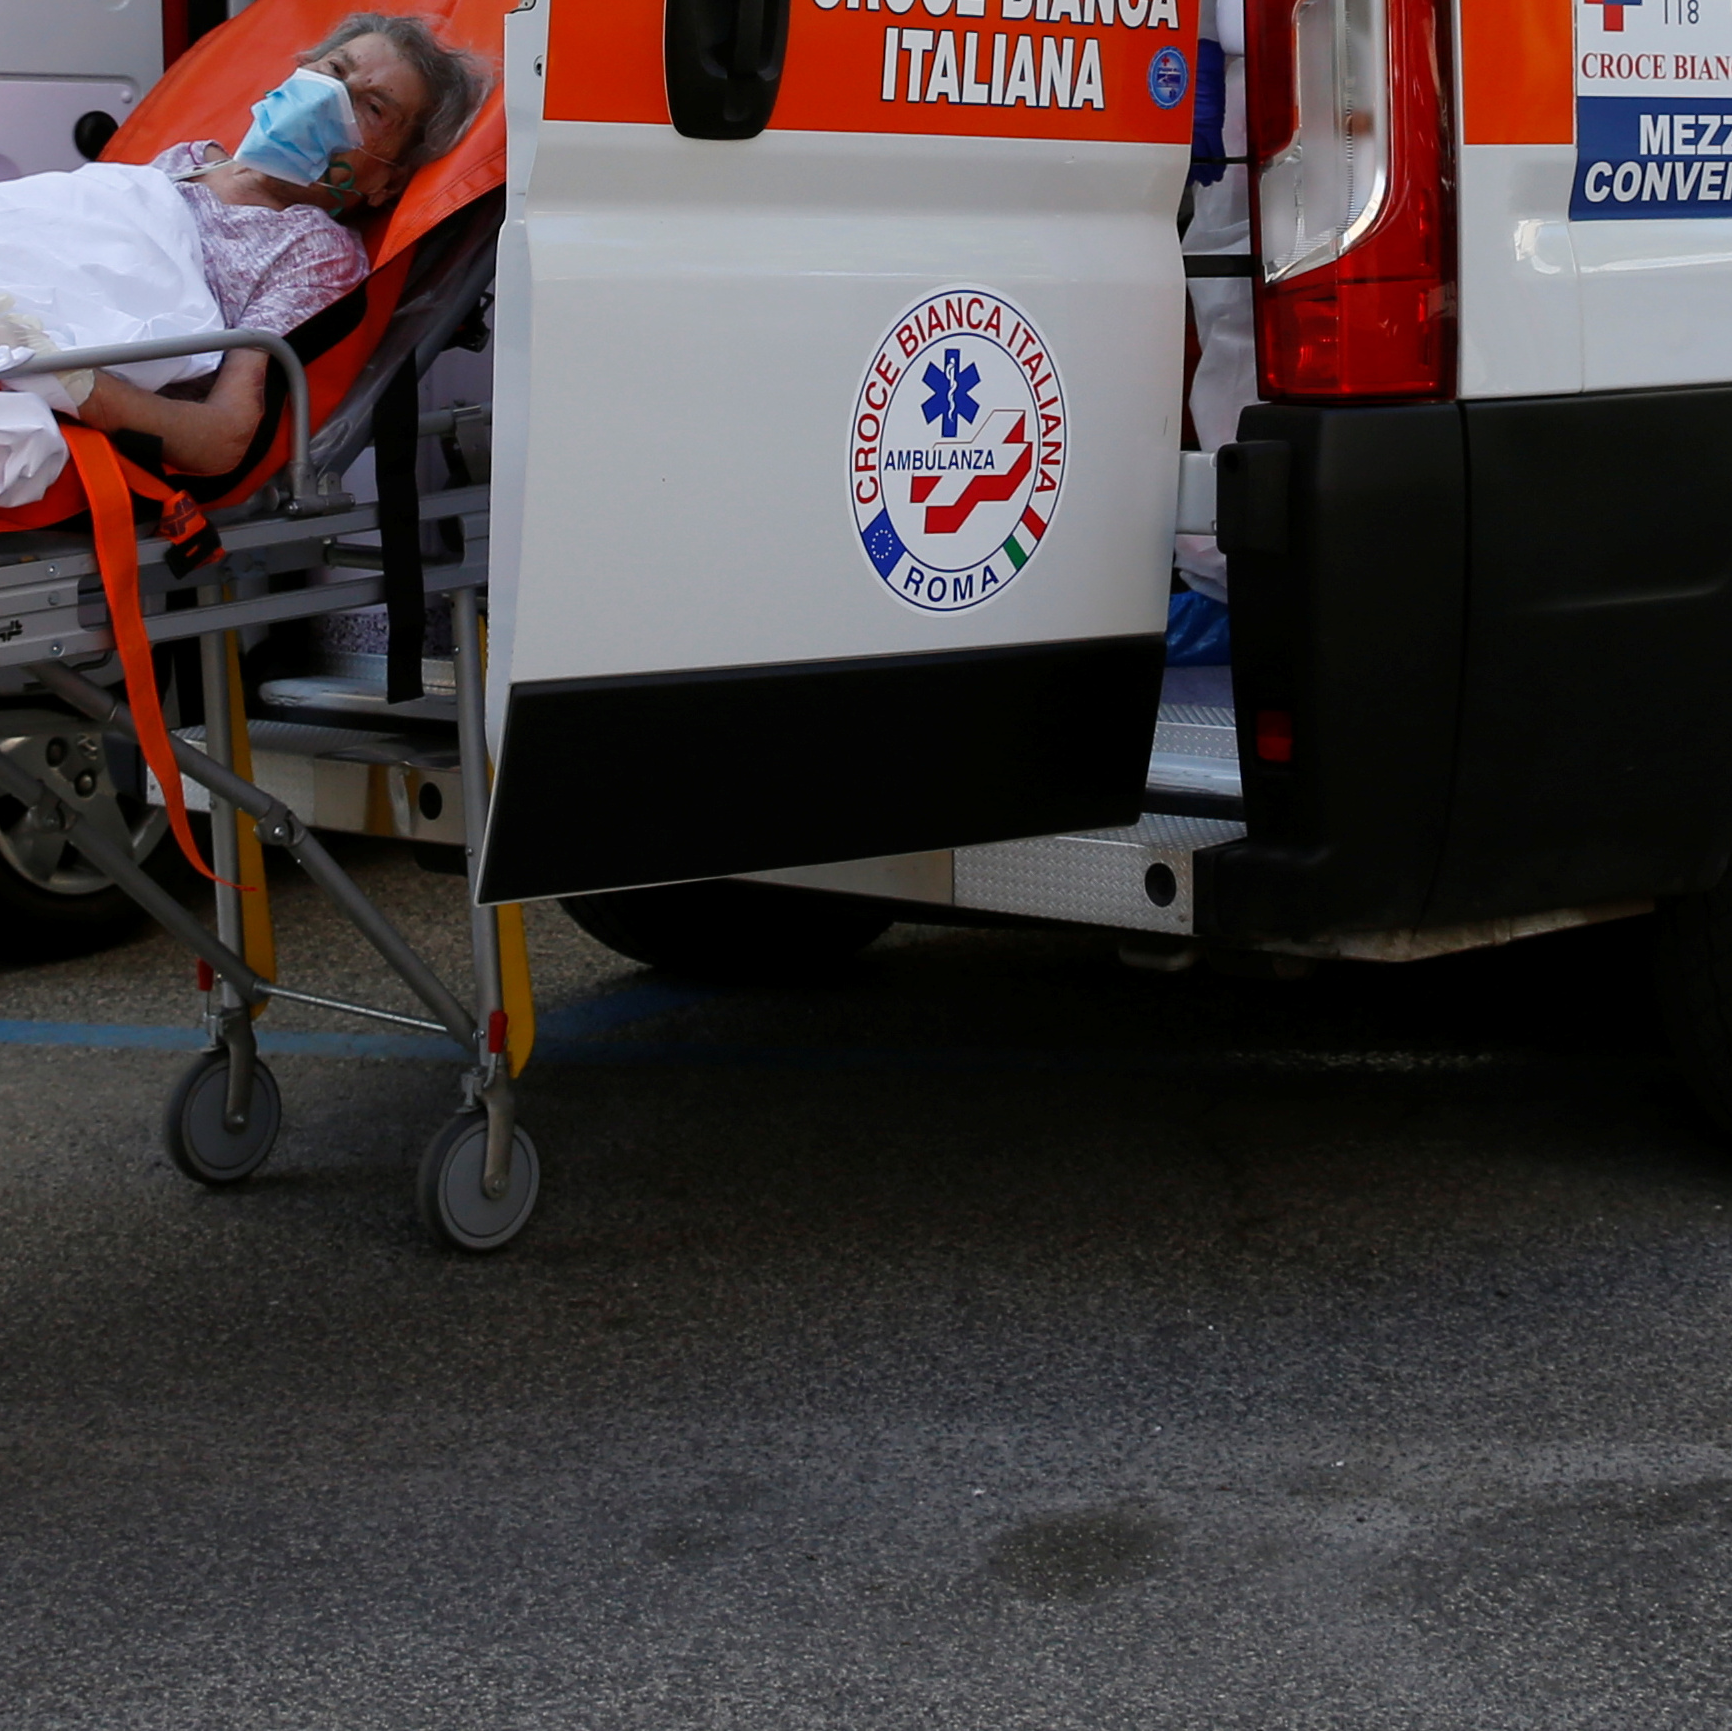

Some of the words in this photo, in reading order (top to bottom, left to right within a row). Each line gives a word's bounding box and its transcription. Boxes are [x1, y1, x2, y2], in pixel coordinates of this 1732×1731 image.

[880, 26, 1105, 110] ITALIANA
[1581, 52, 1666, 80] CROCE
[854, 353, 901, 504] CROCE
[895, 297, 1002, 358] BIANCA
[1007, 321, 1063, 494] ITALIANA
[884, 449, 996, 472] AMBULANZA
[903, 565, 999, 603] ROMA
